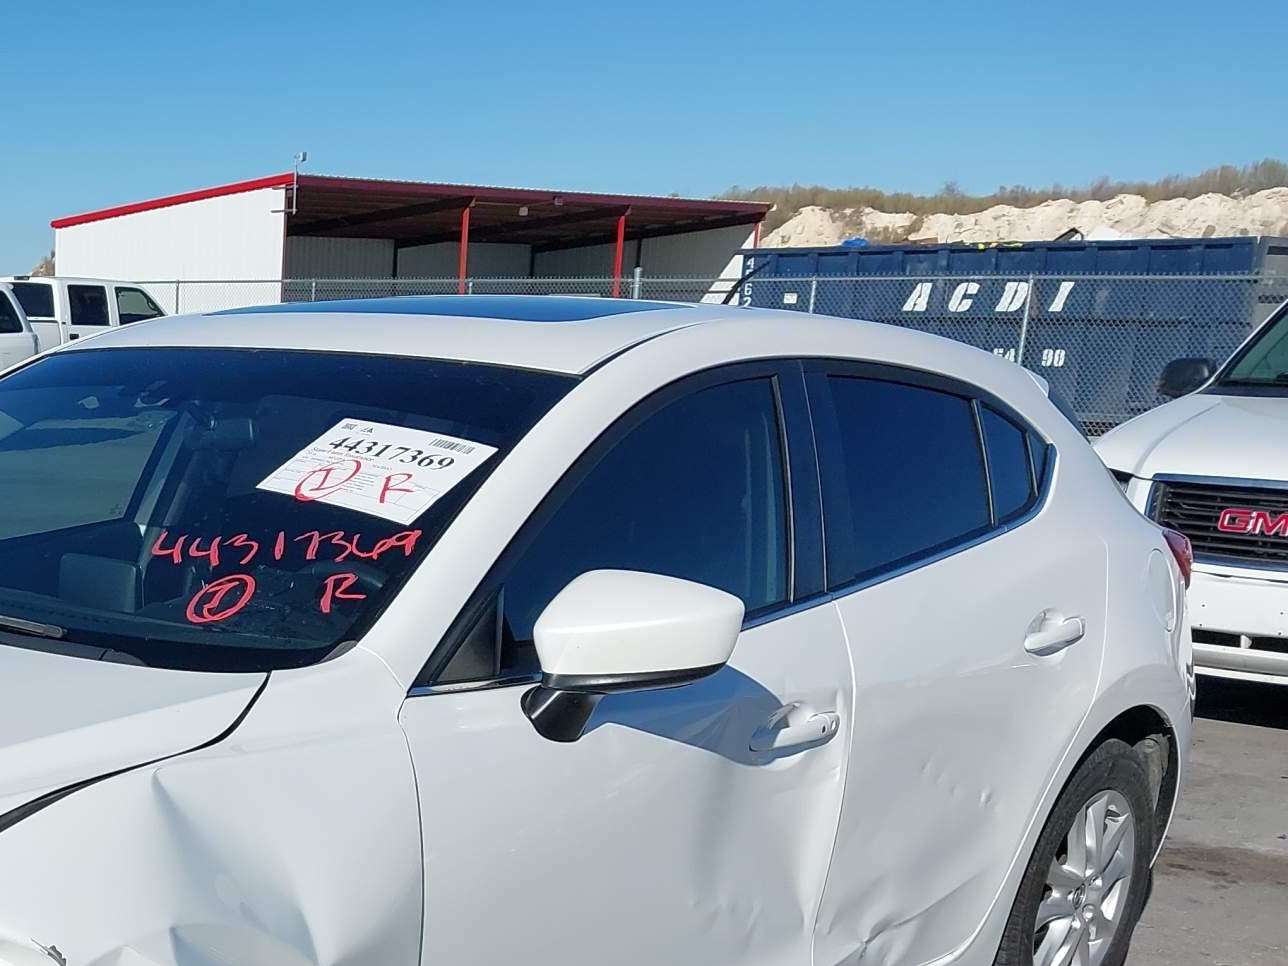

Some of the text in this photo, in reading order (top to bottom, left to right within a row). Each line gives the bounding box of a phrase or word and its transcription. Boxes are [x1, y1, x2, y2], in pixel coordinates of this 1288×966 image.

[902, 282, 1075, 312] ACDI
[329, 436, 455, 471] 44317369
[319, 573, 366, 613] R
